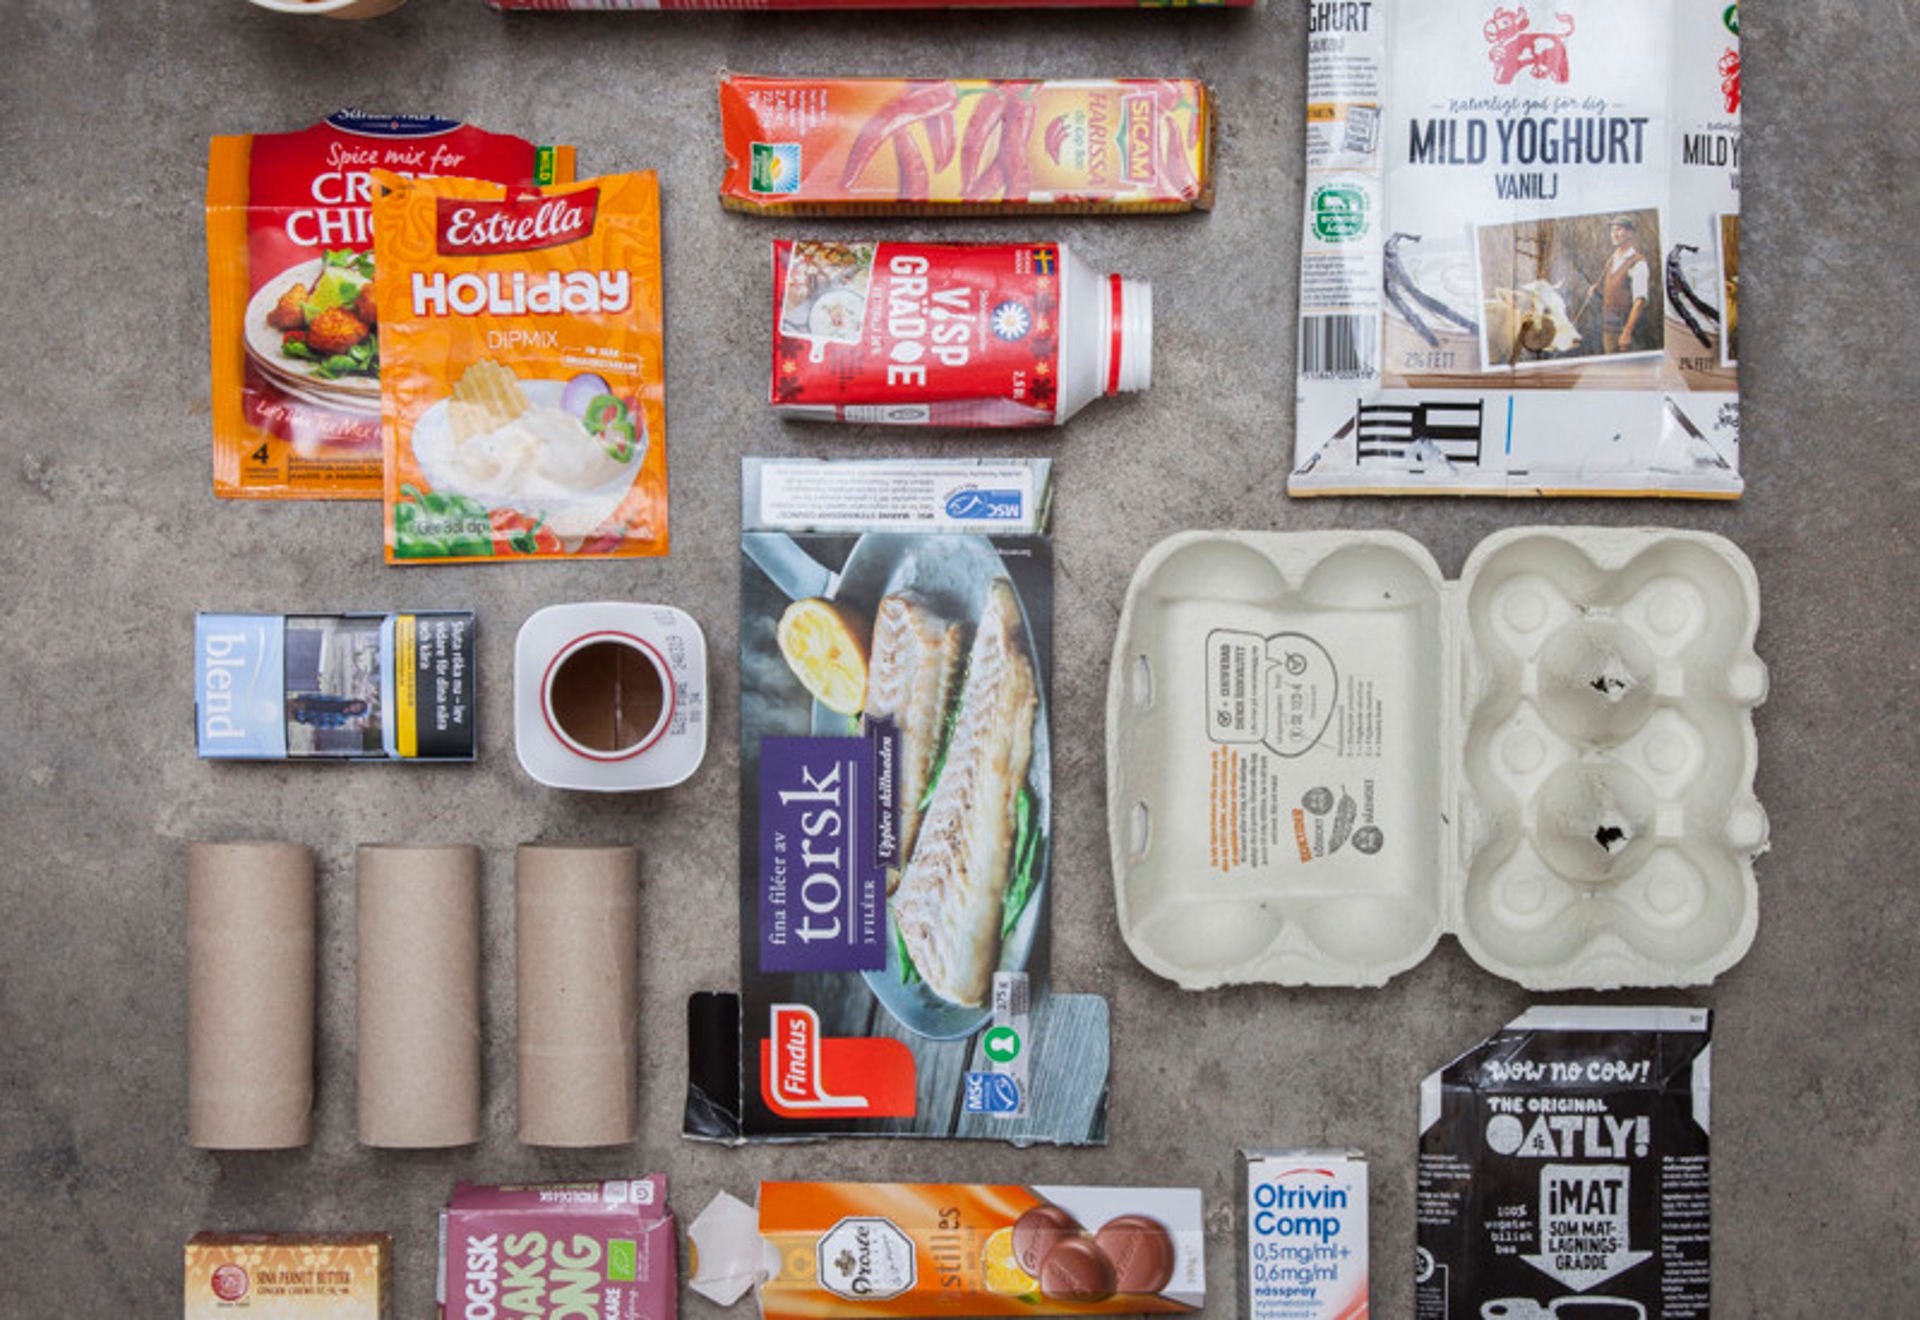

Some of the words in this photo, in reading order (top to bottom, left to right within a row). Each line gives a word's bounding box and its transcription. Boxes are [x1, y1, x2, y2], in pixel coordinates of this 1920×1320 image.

[326, 141, 379, 171] Spice
[384, 146, 426, 166] mix
[430, 144, 466, 172] for
[1088, 92, 1108, 186] HARISSA
[1131, 100, 1151, 178] SICAM
[1408, 119, 1487, 165] MILD
[1495, 117, 1650, 165] YOGHURT
[1683, 133, 1727, 166] MILD
[1495, 174, 1558, 200] VANILJ
[446, 199, 584, 246] Estrella
[488, 329, 559, 350] DIPMIX
[251, 443, 269, 464] 4
[987, 503, 1020, 517] MSC
[205, 633, 246, 740] blend
[878, 735, 893, 808] skillnaden
[774, 831, 787, 853] av
[777, 760, 842, 944] torsk
[878, 811, 897, 857] Upplev
[768, 855, 787, 905] filéer
[860, 880, 876, 935] FILÉER
[768, 910, 787, 945] fina
[784, 1018, 807, 1095] Findus
[1550, 1062, 1584, 1082] no
[968, 1074, 983, 1110] MSC
[1487, 1096, 1524, 1113] THE
[1527, 1097, 1609, 1113] ORIGINAL
[1485, 1113, 1651, 1158] OATLY!
[1254, 1183, 1348, 1209] Otrivin
[1497, 1204, 1528, 1217] 100%
[1254, 1211, 1341, 1244] Comp
[1549, 1221, 1578, 1236] SOM
[501, 1231, 549, 1320] AKS
[851, 1225, 873, 1295] Droste
